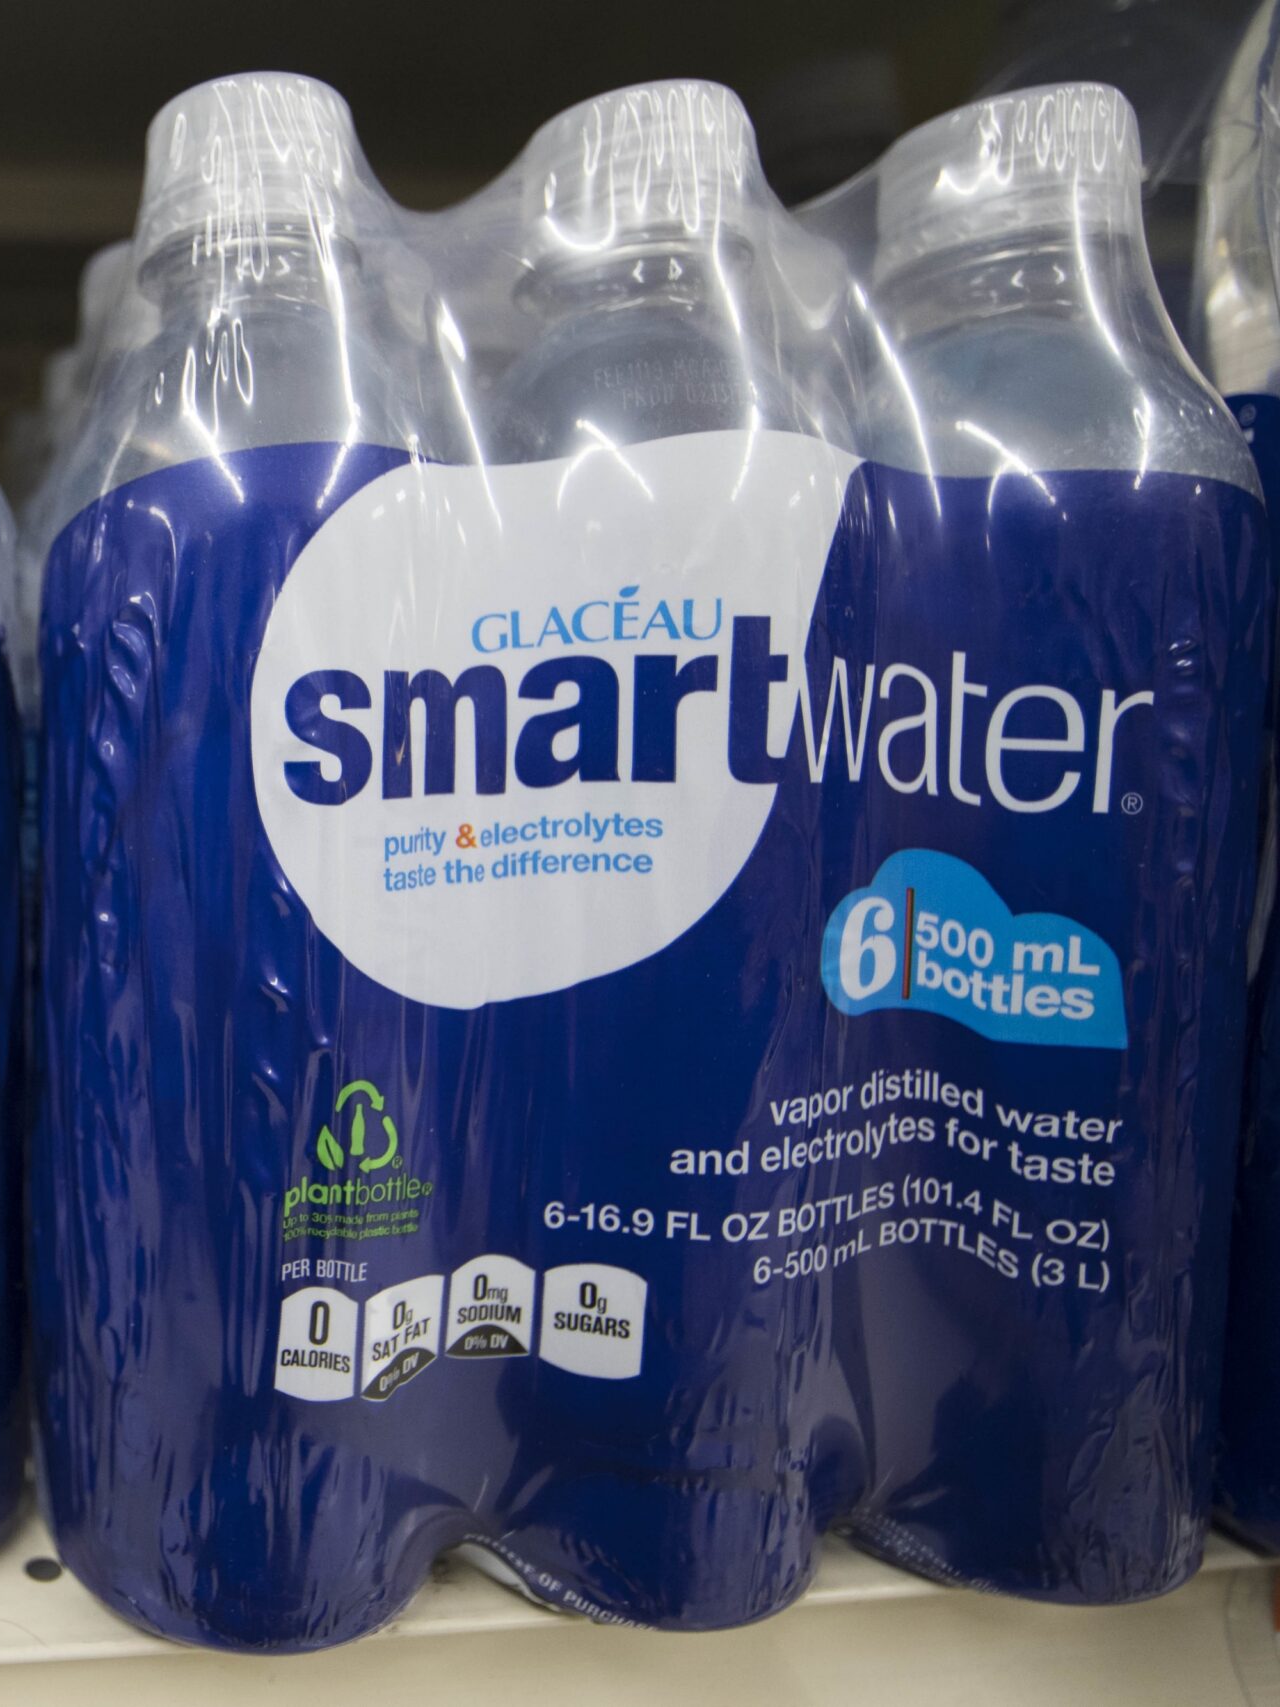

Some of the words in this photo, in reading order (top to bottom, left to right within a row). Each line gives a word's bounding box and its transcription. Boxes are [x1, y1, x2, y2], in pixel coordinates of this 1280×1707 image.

[471, 584, 722, 654] GLACÉAU
[384, 827, 446, 862] purity
[455, 823, 477, 848] &
[480, 812, 664, 847] electrolytes
[383, 864, 436, 892] taste
[443, 859, 485, 885] the
[491, 850, 653, 879] difference
[839, 896, 897, 1001] 6
[915, 911, 995, 968] 500
[1012, 935, 1101, 976] mL
[916, 951, 1095, 1020] bottles
[770, 1082, 854, 1130] vapor
[860, 1069, 984, 1117] distilled
[996, 1102, 1123, 1145] water
[670, 1142, 749, 1175] and
[760, 1111, 935, 1173] electrolytes
[945, 1117, 998, 1161] for
[1008, 1145, 1116, 1186] taste
[543, 1201, 655, 1236] 6-16.9
[666, 1211, 711, 1242] FL
[721, 1212, 769, 1243] OZ
[777, 1181, 894, 1238] BOTTLES
[901, 1174, 983, 1215] (101.4
[992, 1200, 1034, 1240] FL
[1045, 1220, 1111, 1253] OZ)
[281, 1258, 310, 1281] PER
[316, 1259, 368, 1282] BOTTLE
[753, 1244, 827, 1284] 6-500
[833, 1229, 872, 1266] mL
[879, 1217, 1019, 1280] BOTTLES
[1031, 1252, 1065, 1288] (3
[1077, 1260, 1110, 1293] L)
[309, 1300, 330, 1345] 0
[456, 1305, 522, 1325] SODIUM
[553, 1311, 631, 1339] SUGARS
[280, 1349, 351, 1374] CALORIES
[372, 1334, 400, 1361] SAT
[404, 1317, 431, 1345] FAT
[464, 1336, 488, 1351] 0%
[490, 1334, 509, 1349] DV
[402, 1352, 420, 1373] DV
[538, 1572, 563, 1592] OF
